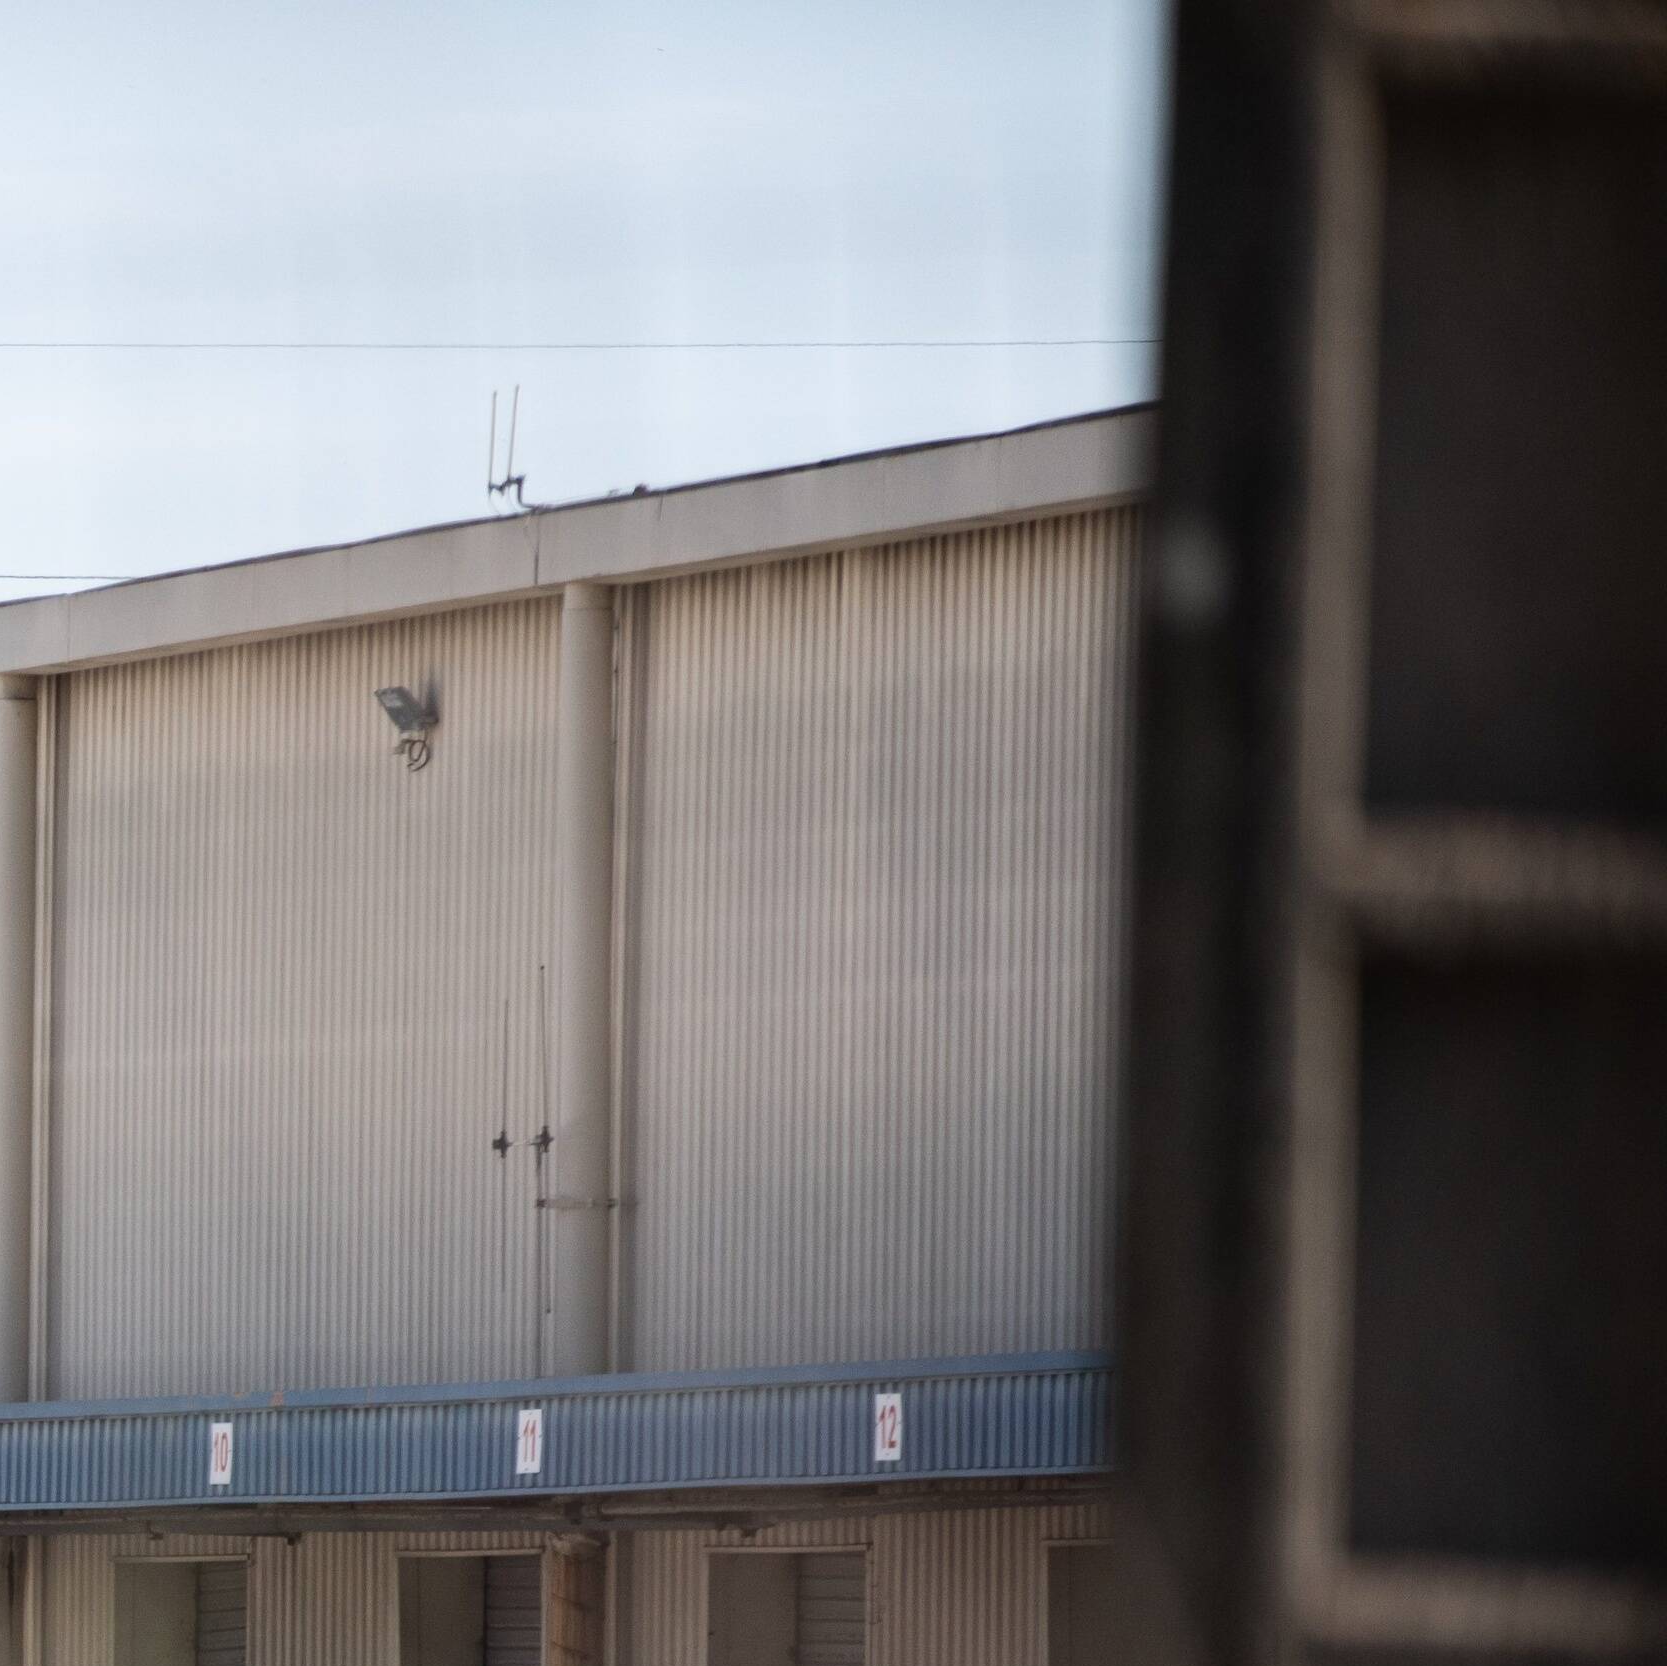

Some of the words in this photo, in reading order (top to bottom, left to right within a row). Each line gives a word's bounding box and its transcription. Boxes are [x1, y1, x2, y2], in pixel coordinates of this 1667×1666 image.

[523, 1420, 536, 1462] 11
[878, 1405, 896, 1448] 12
[214, 1433, 227, 1473] 10
